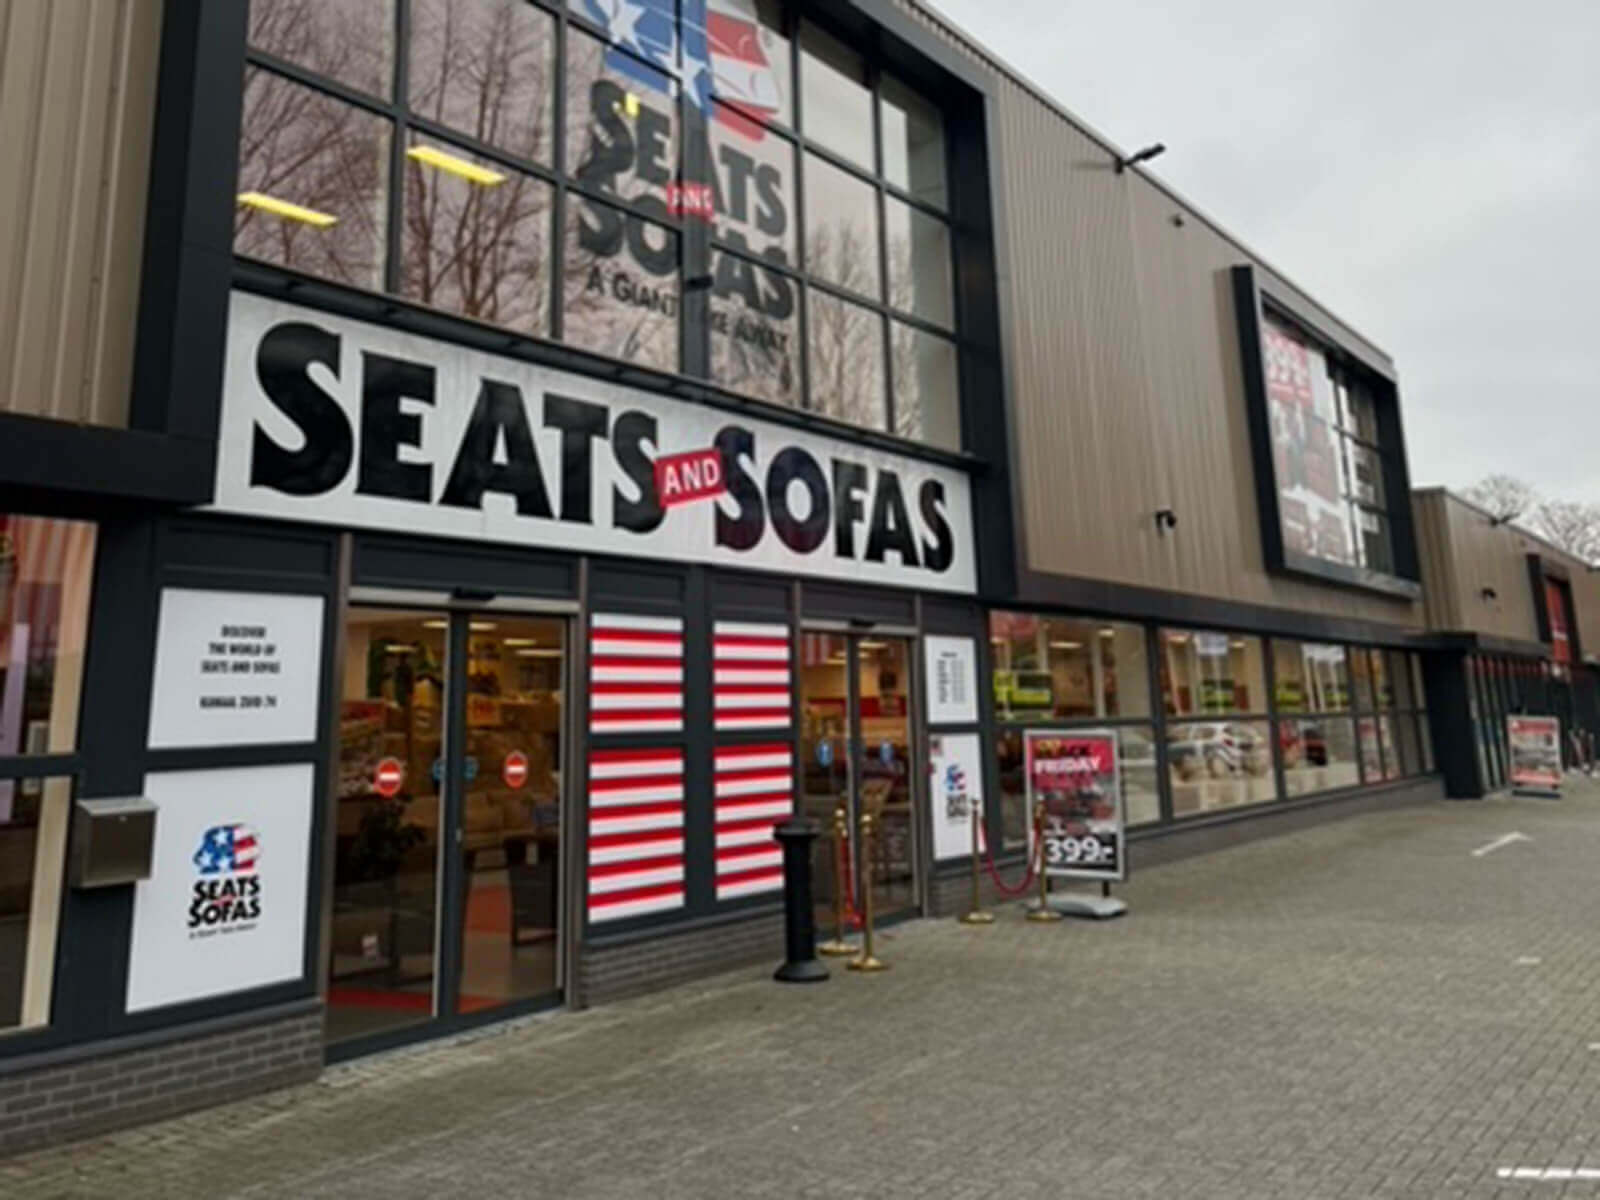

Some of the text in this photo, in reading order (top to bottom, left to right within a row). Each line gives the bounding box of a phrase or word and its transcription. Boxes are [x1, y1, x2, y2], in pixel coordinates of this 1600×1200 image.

[577, 79, 787, 237] SEATS
[578, 172, 794, 320] SOAS
[250, 321, 955, 573] SEATS AND SOFAS
[1035, 757, 1101, 774] FRIDAY
[188, 900, 261, 929] SOFAS
[193, 875, 260, 902] SEATS
